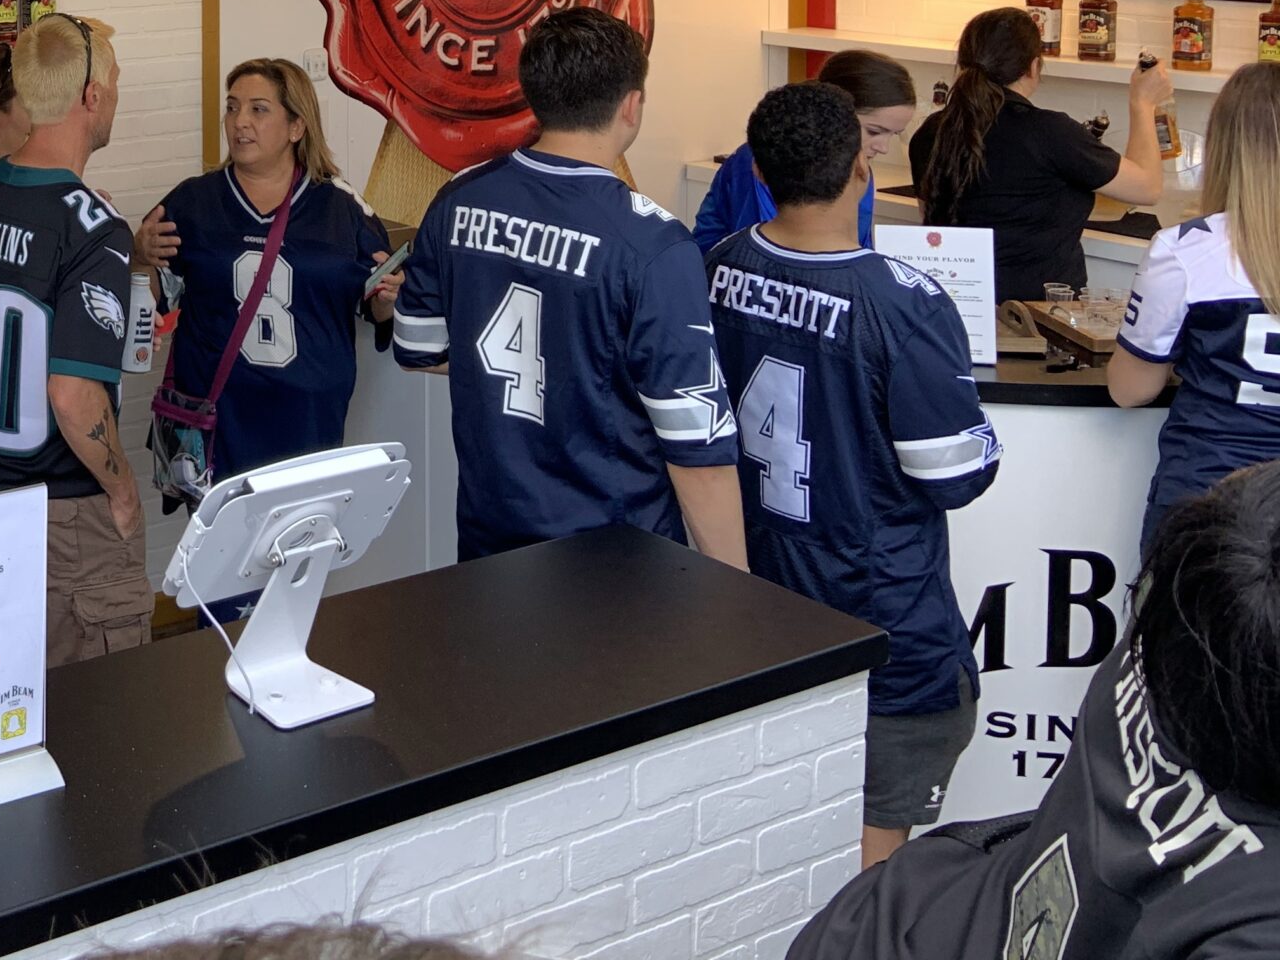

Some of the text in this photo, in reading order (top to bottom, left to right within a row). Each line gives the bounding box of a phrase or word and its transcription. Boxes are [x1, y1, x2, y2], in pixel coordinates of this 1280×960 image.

[450, 205, 600, 277] PRESCOTT
[134, 307, 153, 344] lite
[233, 250, 297, 368] 8
[476, 281, 545, 427] 4
[735, 354, 811, 523] 4
[11, 684, 34, 699] BEAM
[985, 711, 1078, 742] SIN
[1013, 750, 1066, 779] 17
[1114, 632, 1265, 884] RESCOTT
